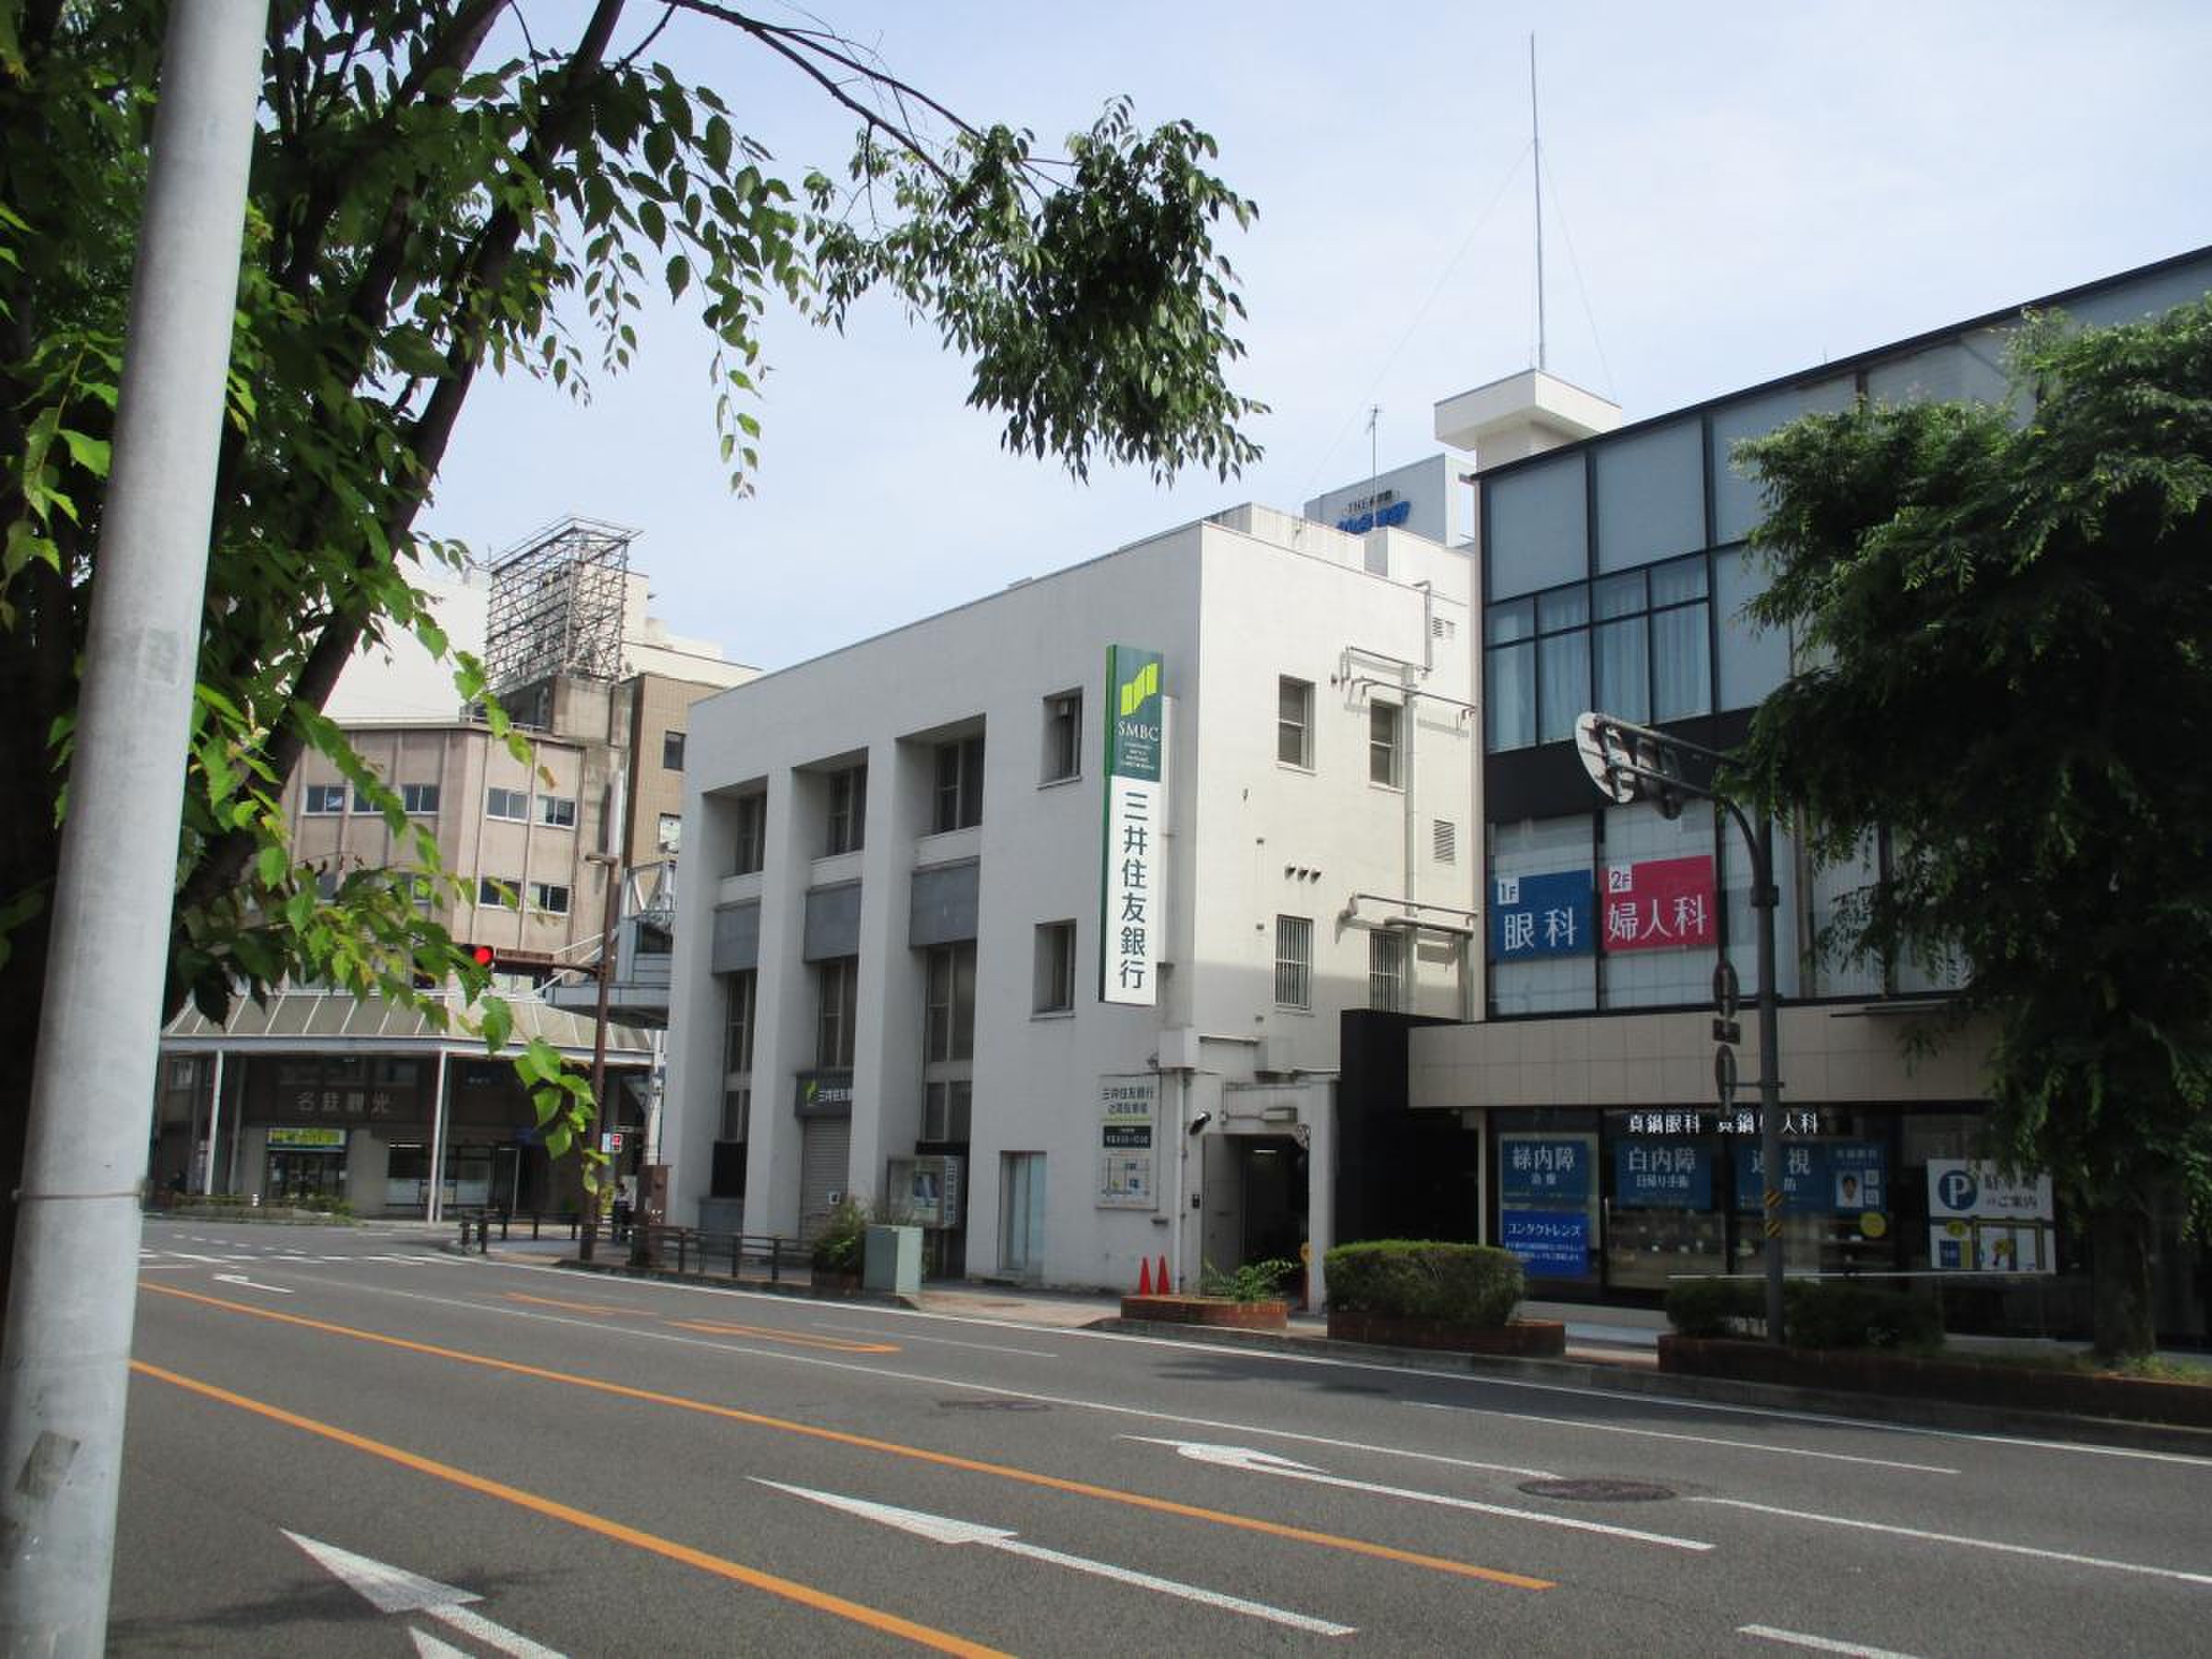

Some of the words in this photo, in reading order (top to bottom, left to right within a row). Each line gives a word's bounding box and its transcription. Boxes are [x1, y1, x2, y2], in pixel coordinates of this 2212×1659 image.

[1119, 722, 1159, 741] SMBC
[1120, 792, 1148, 989] 三井住友銀行
[1613, 871, 1630, 889] 2F
[1500, 884, 1517, 900] 1F
[1504, 907, 1577, 951] 眼科
[1607, 895, 1706, 942] 婦人科
[1629, 1147, 1696, 1173] 白内障
[1507, 1223, 1580, 1238] コンタクトレンズ
